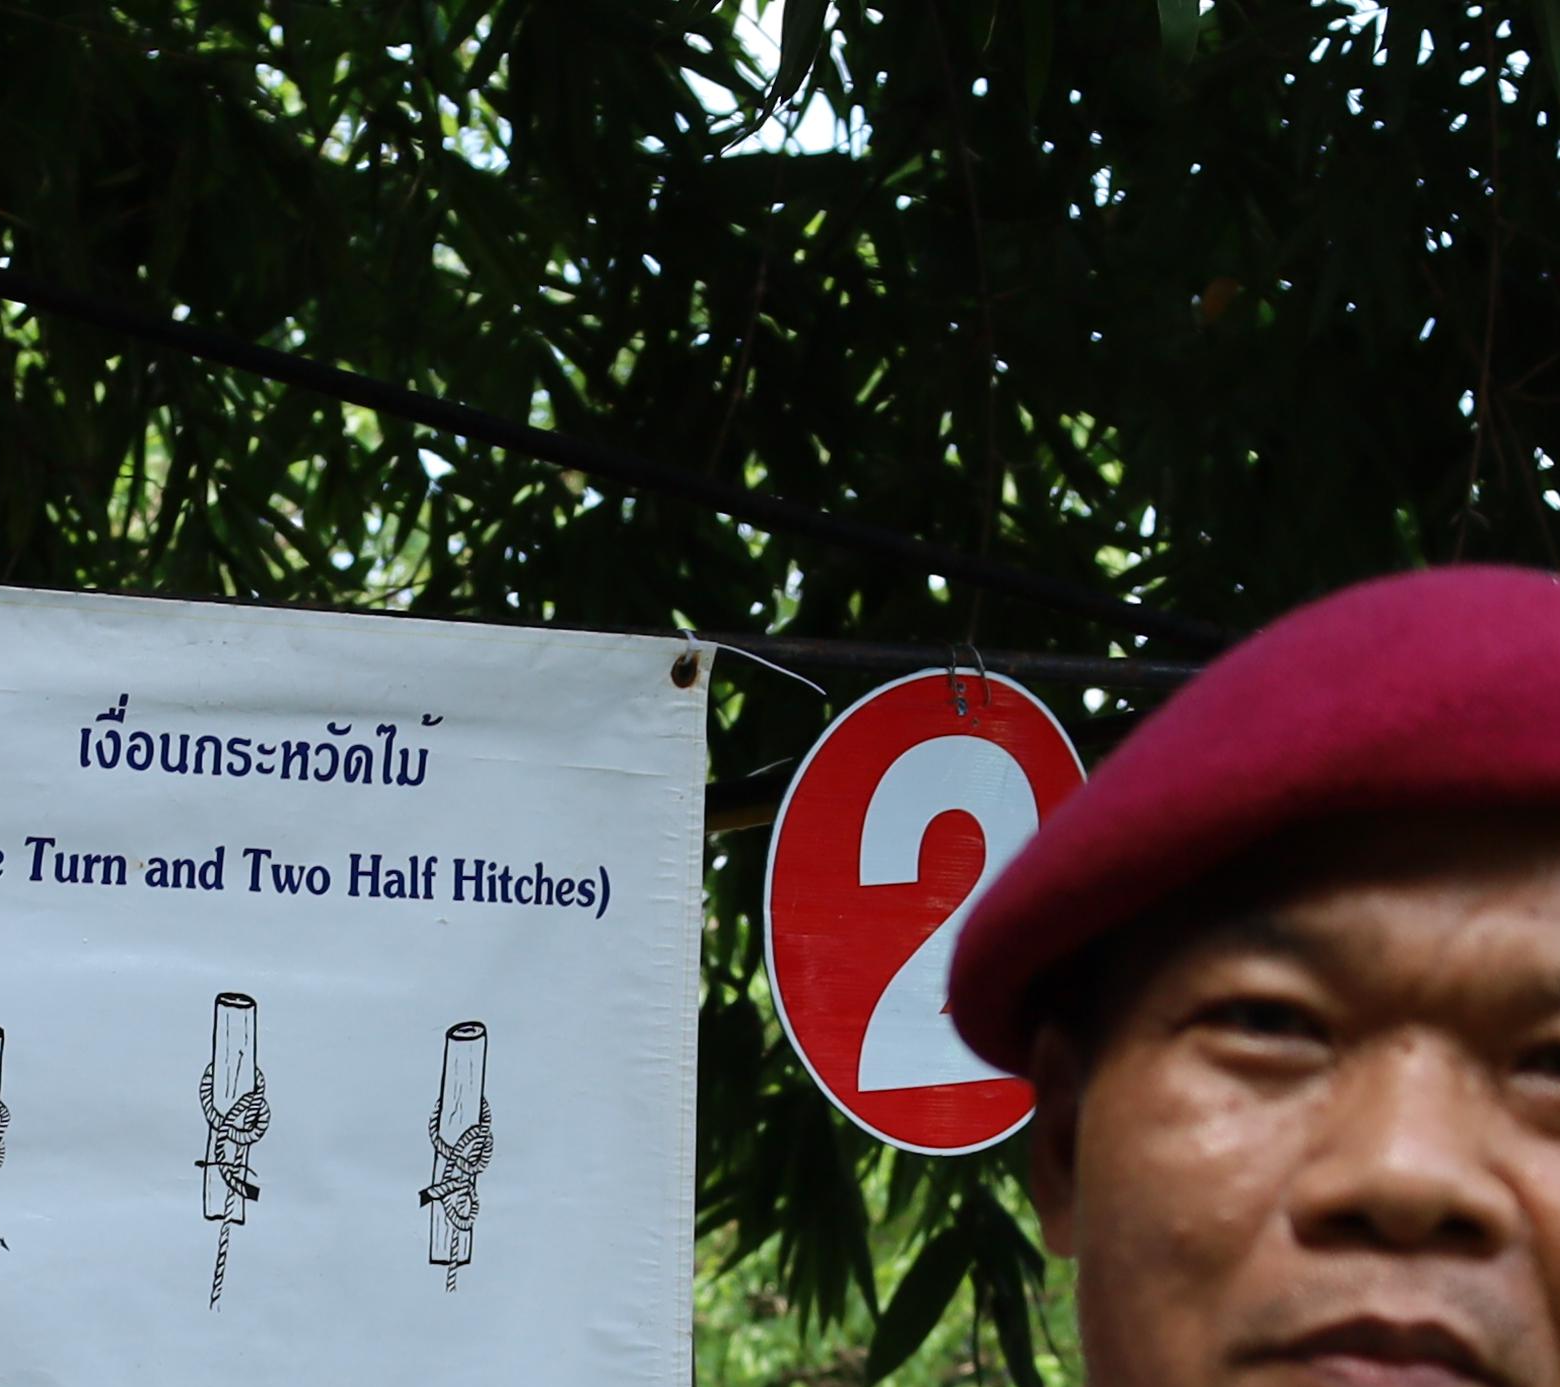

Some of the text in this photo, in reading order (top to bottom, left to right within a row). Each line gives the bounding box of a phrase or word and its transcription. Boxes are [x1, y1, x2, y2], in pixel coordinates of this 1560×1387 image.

[80, 693, 443, 786] เงื่อนกระหวัดไม้
[24, 836, 127, 885] Turn
[144, 846, 225, 891] and
[242, 848, 330, 894] Two
[347, 853, 438, 900] Half
[452, 857, 610, 920] Hitches)
[858, 735, 1039, 1092] 2
